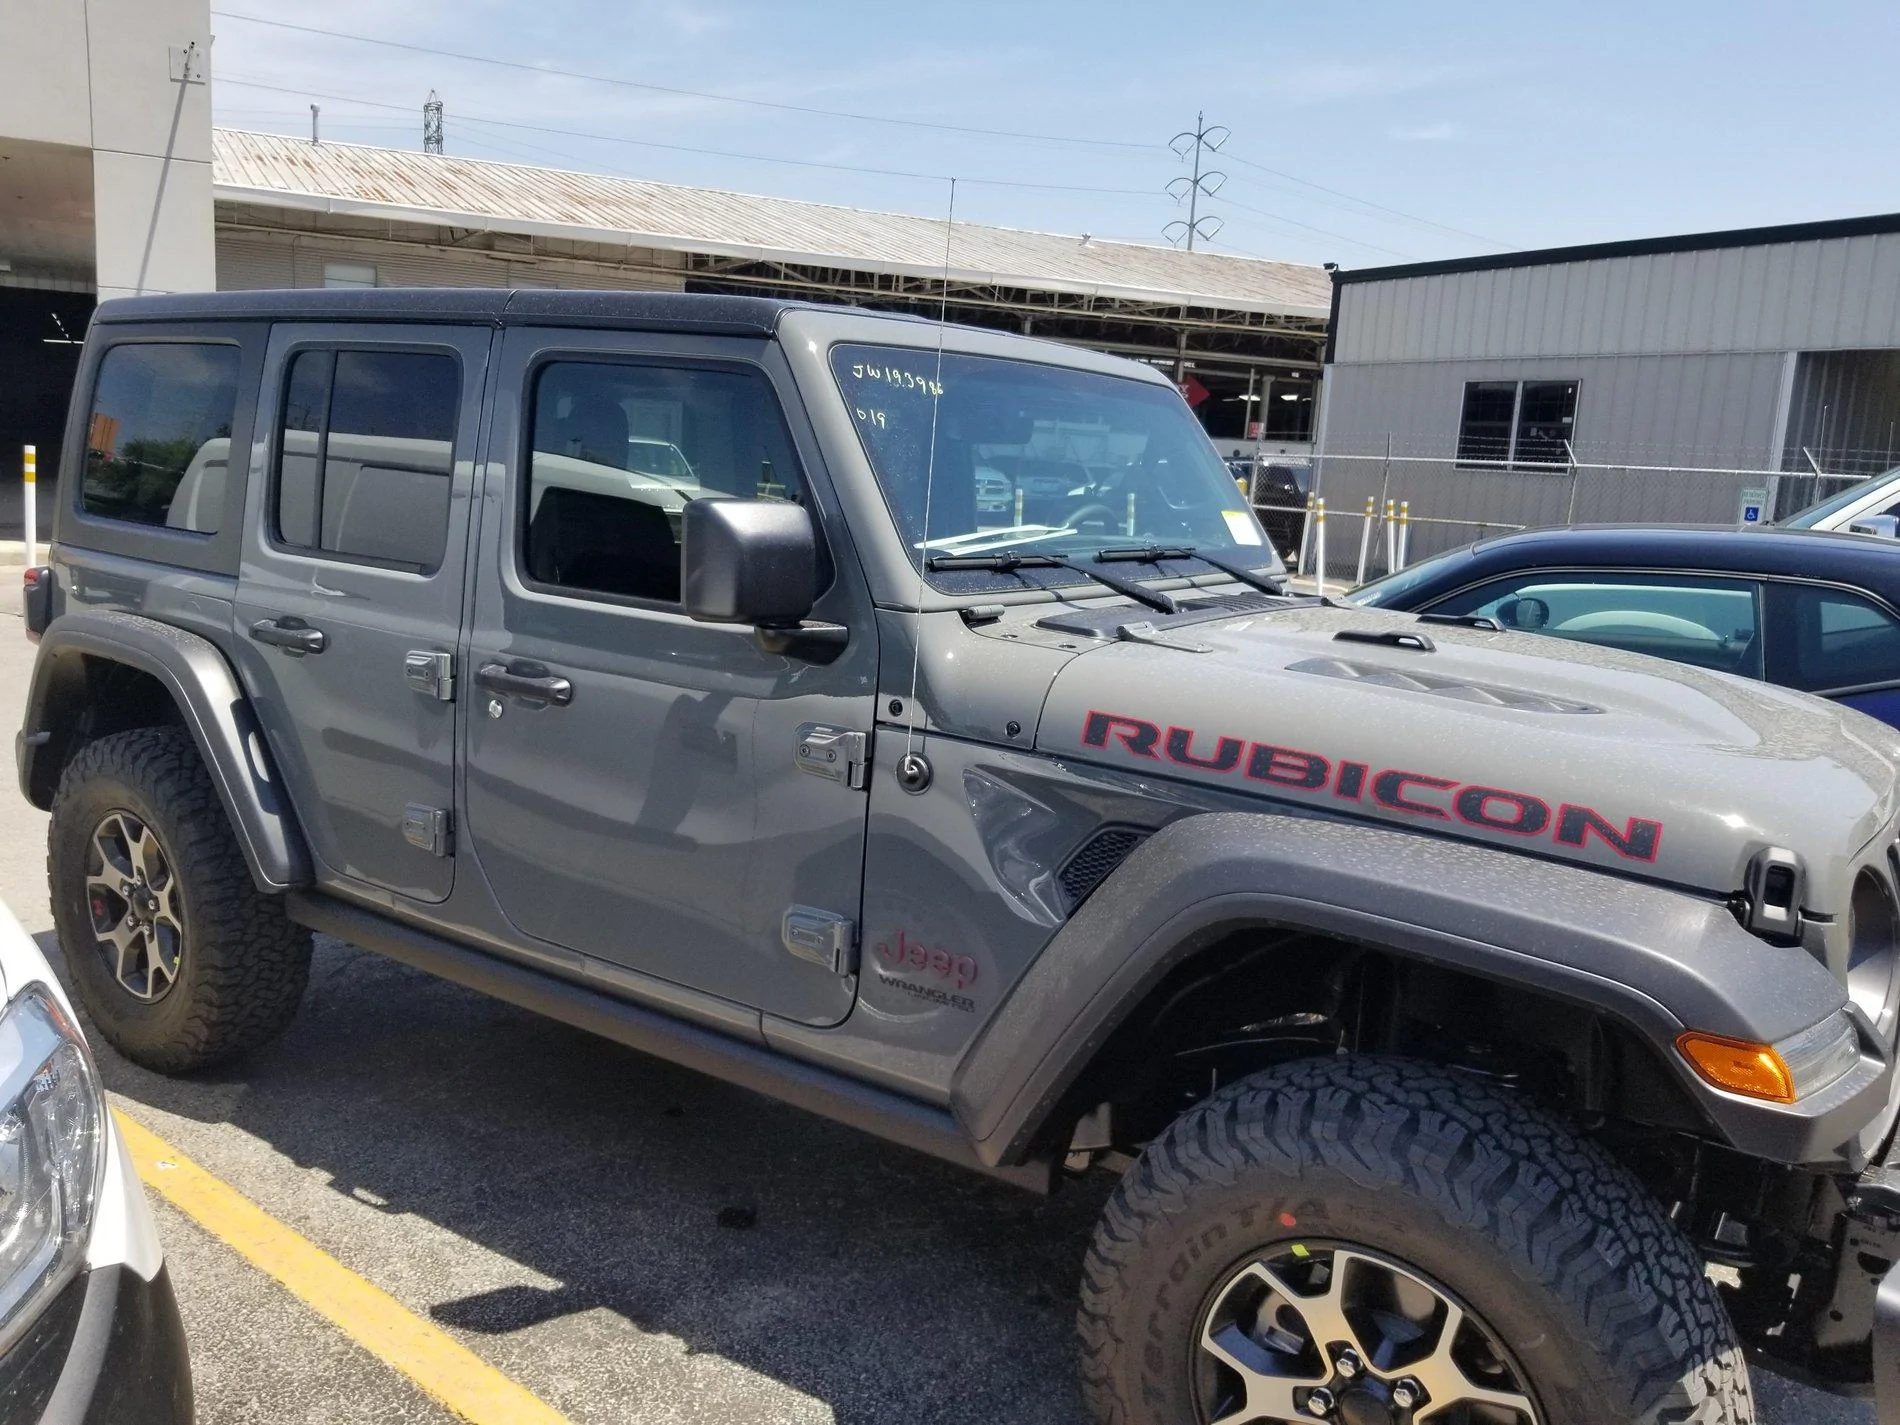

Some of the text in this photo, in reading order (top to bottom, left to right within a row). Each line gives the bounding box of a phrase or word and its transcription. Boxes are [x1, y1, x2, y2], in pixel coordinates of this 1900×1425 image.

[1081, 709, 1663, 864] RUBICON
[875, 927, 979, 990] Jeep
[878, 973, 976, 1013] WRANGLER
